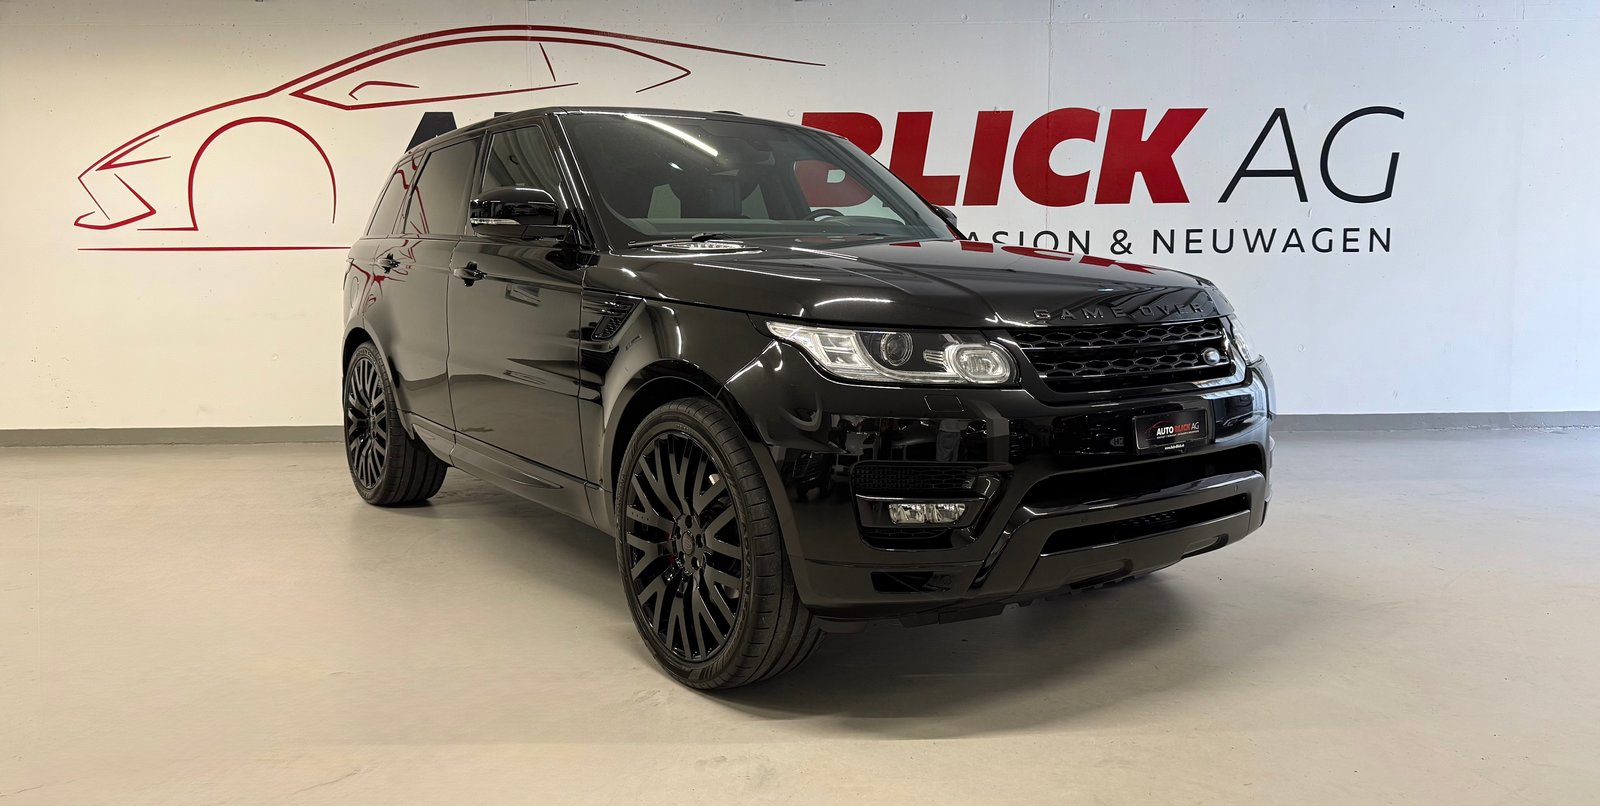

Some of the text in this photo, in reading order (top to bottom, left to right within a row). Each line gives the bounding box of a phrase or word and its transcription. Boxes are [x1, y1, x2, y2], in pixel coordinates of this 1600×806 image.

[797, 106, 1405, 206] BLICK AG
[964, 227, 1391, 254] SION & NEUWAGEN
[1034, 304, 1204, 320] GAME OVER
[1156, 426, 1174, 436] AUTO
